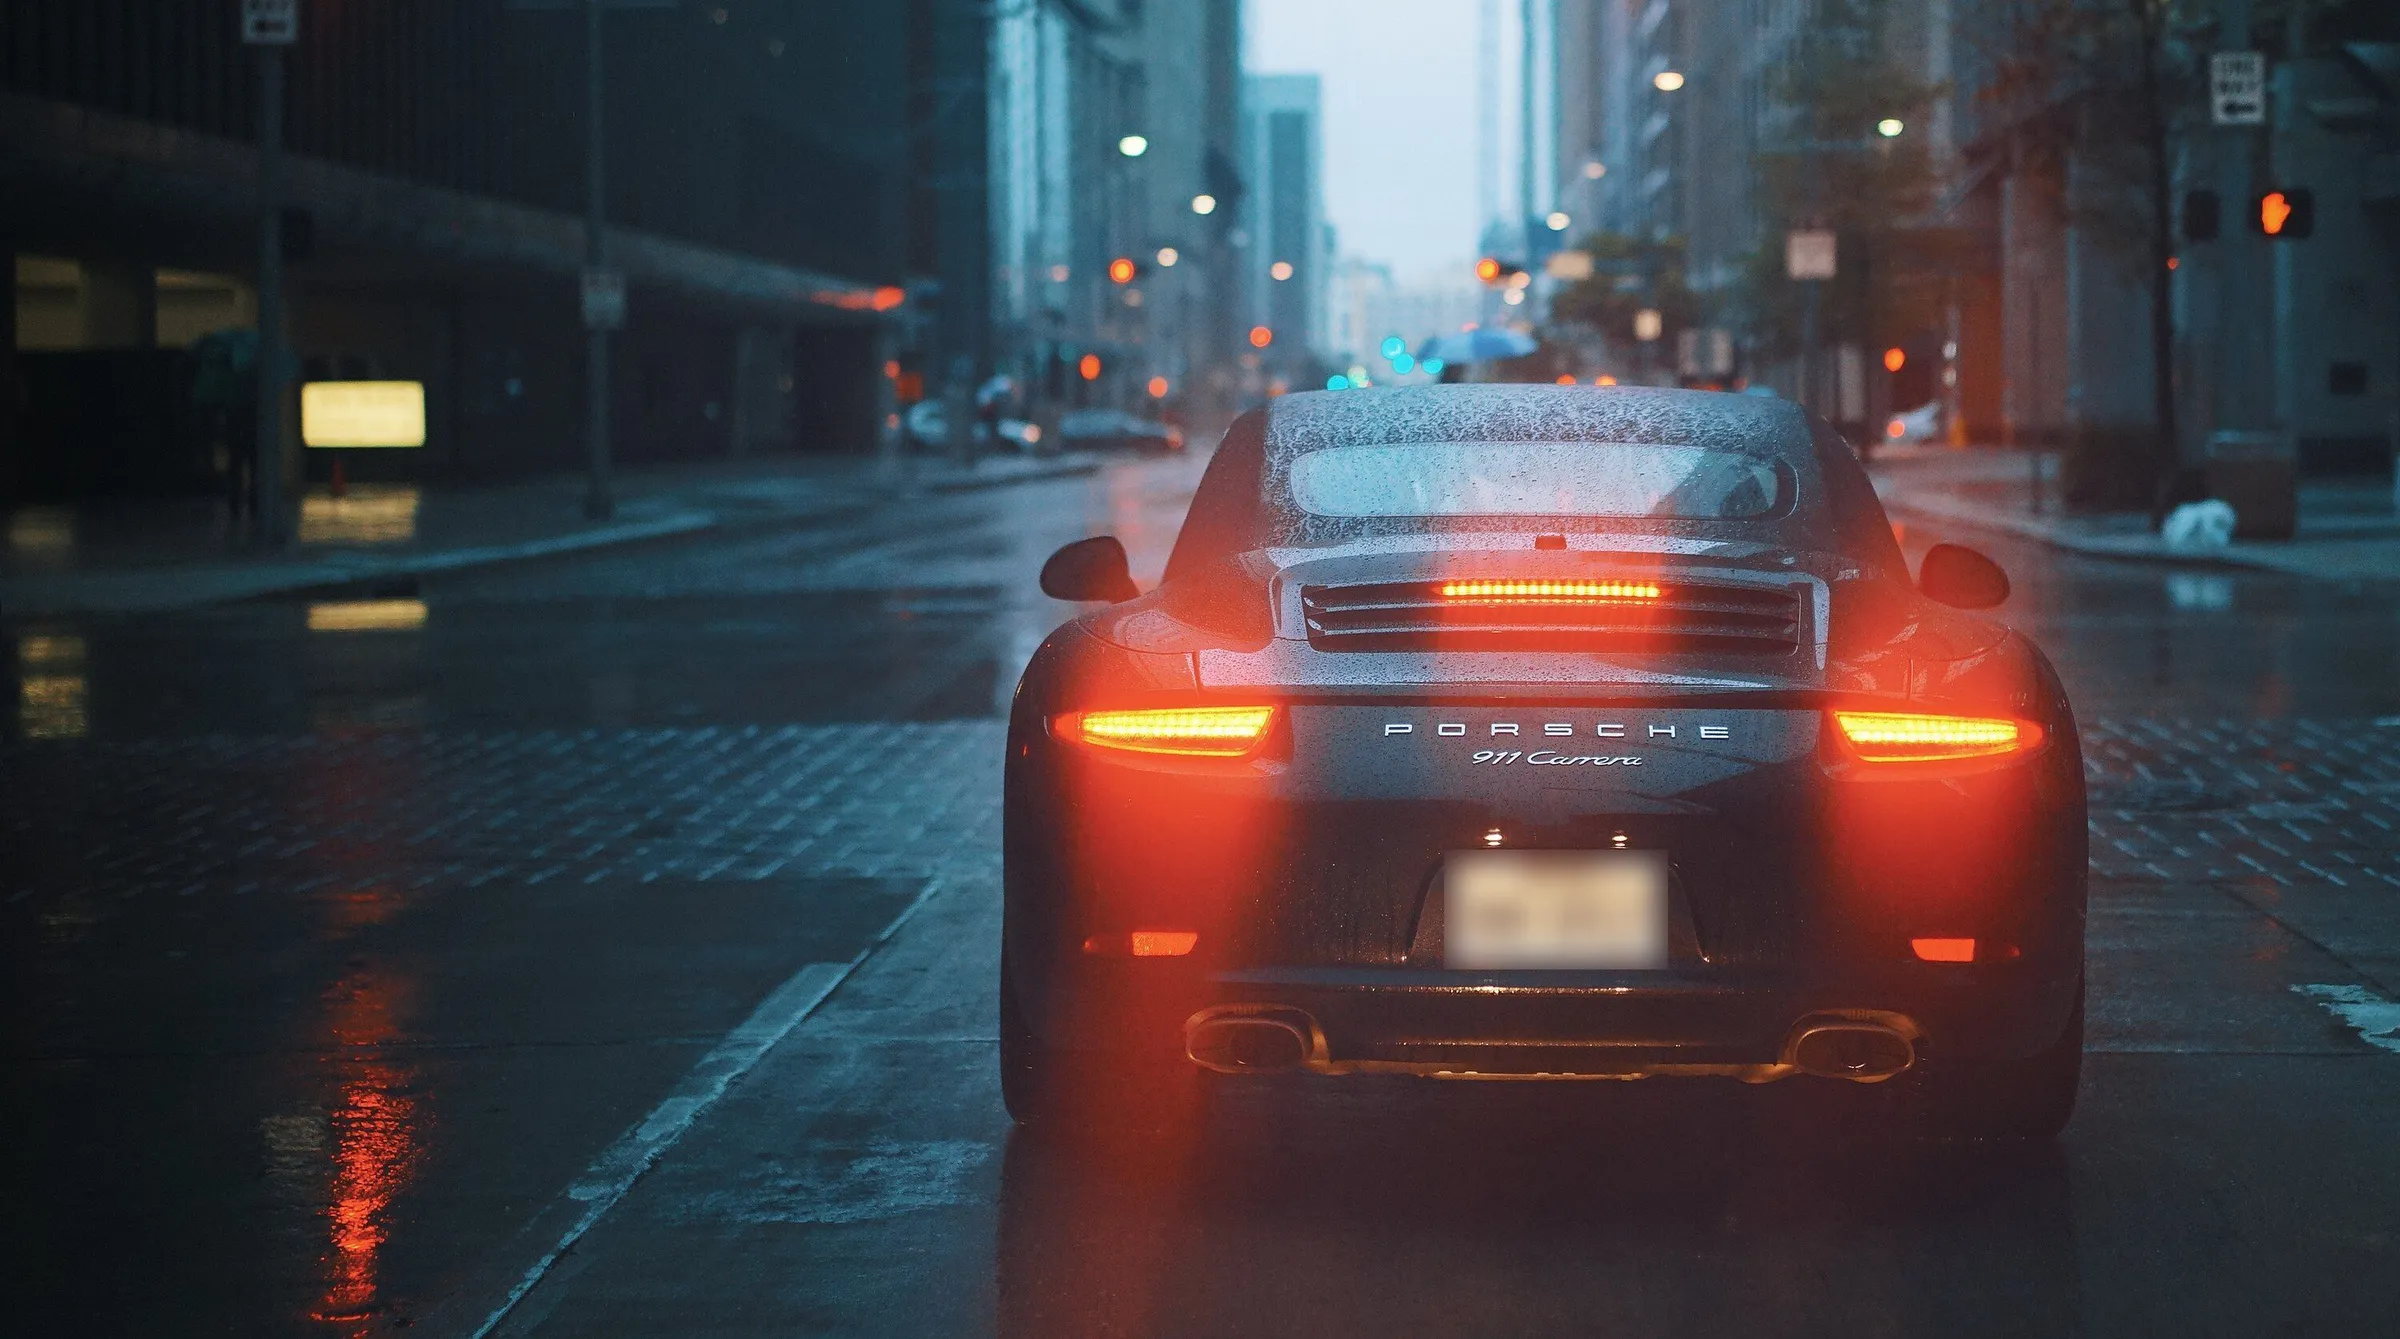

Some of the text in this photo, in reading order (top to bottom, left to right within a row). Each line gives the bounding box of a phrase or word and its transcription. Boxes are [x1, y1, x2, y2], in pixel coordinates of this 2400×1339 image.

[1384, 723, 1730, 739] PORSCHE
[1472, 750, 1643, 766] 911 Carrera
